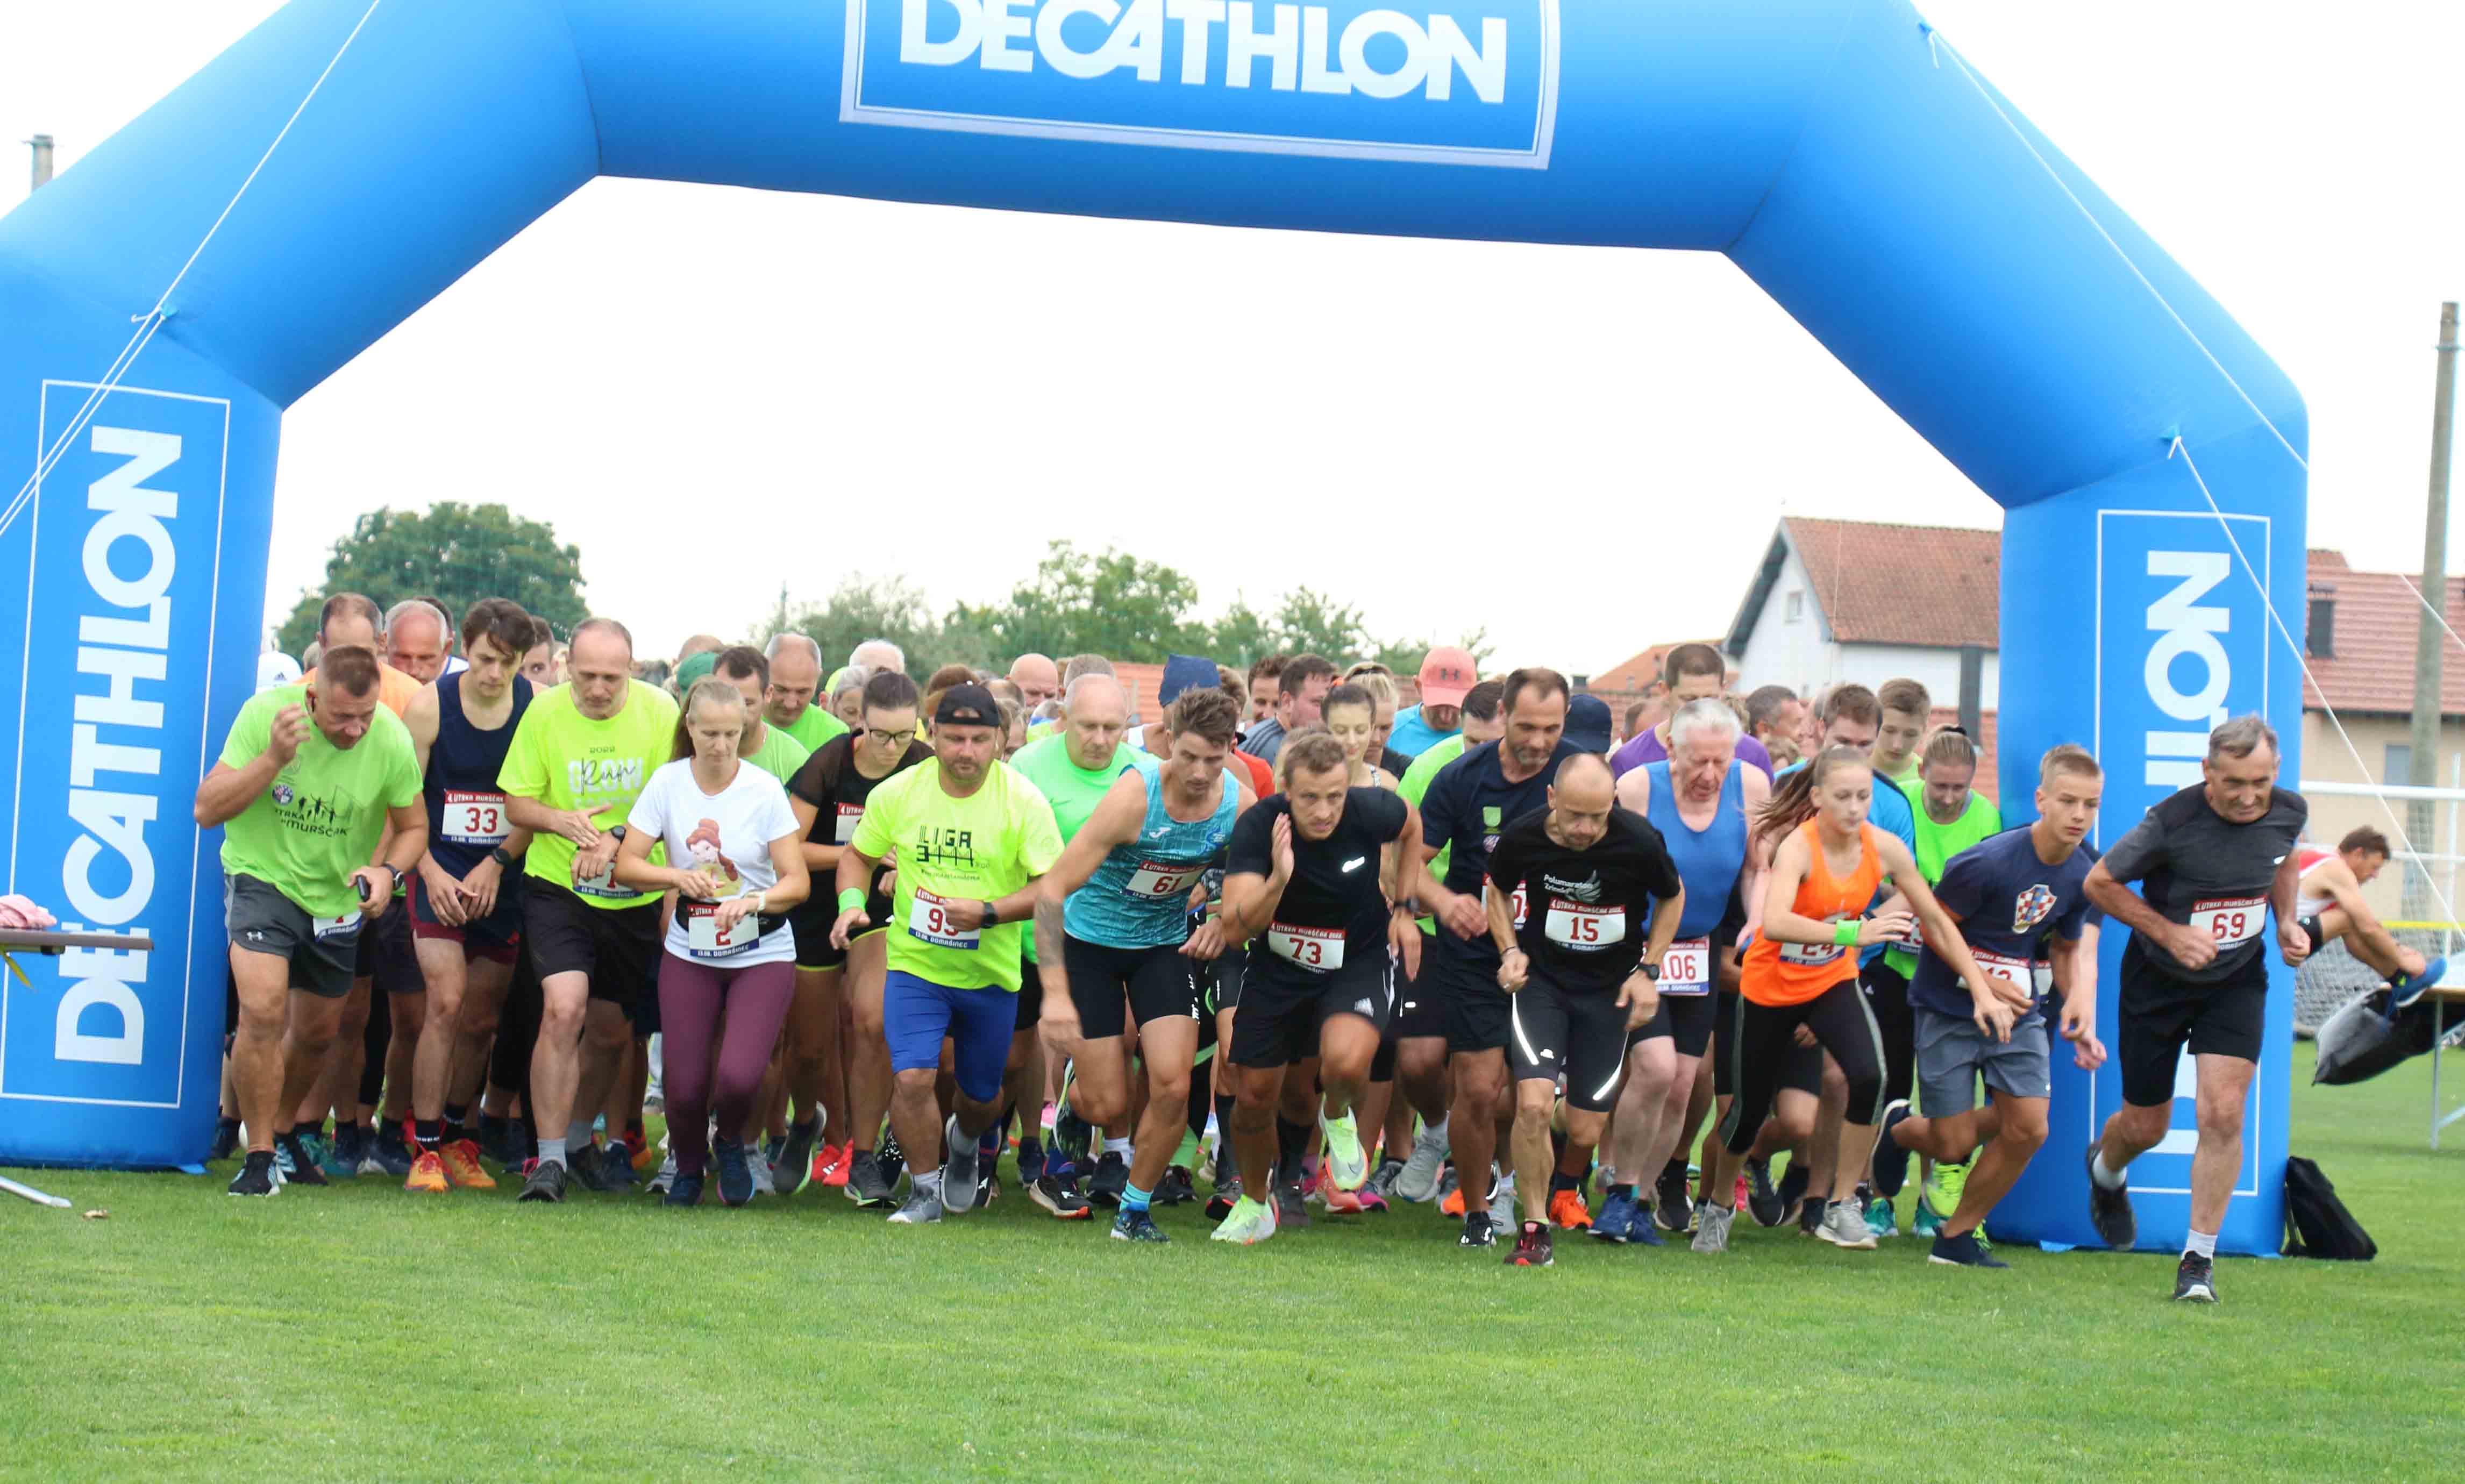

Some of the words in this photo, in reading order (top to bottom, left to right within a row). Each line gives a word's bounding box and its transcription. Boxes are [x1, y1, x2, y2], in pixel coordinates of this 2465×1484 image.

[899, 0, 1507, 104] DECATHLON
[54, 425, 183, 1065] DECATHLON
[567, 757, 644, 793] GLOW
[464, 807, 498, 833] 33
[918, 825, 972, 848] LIGA
[1152, 876, 1182, 893] 61
[1570, 916, 1599, 942] 15
[2212, 912, 2246, 940] 69
[1289, 938, 1322, 965] 73
